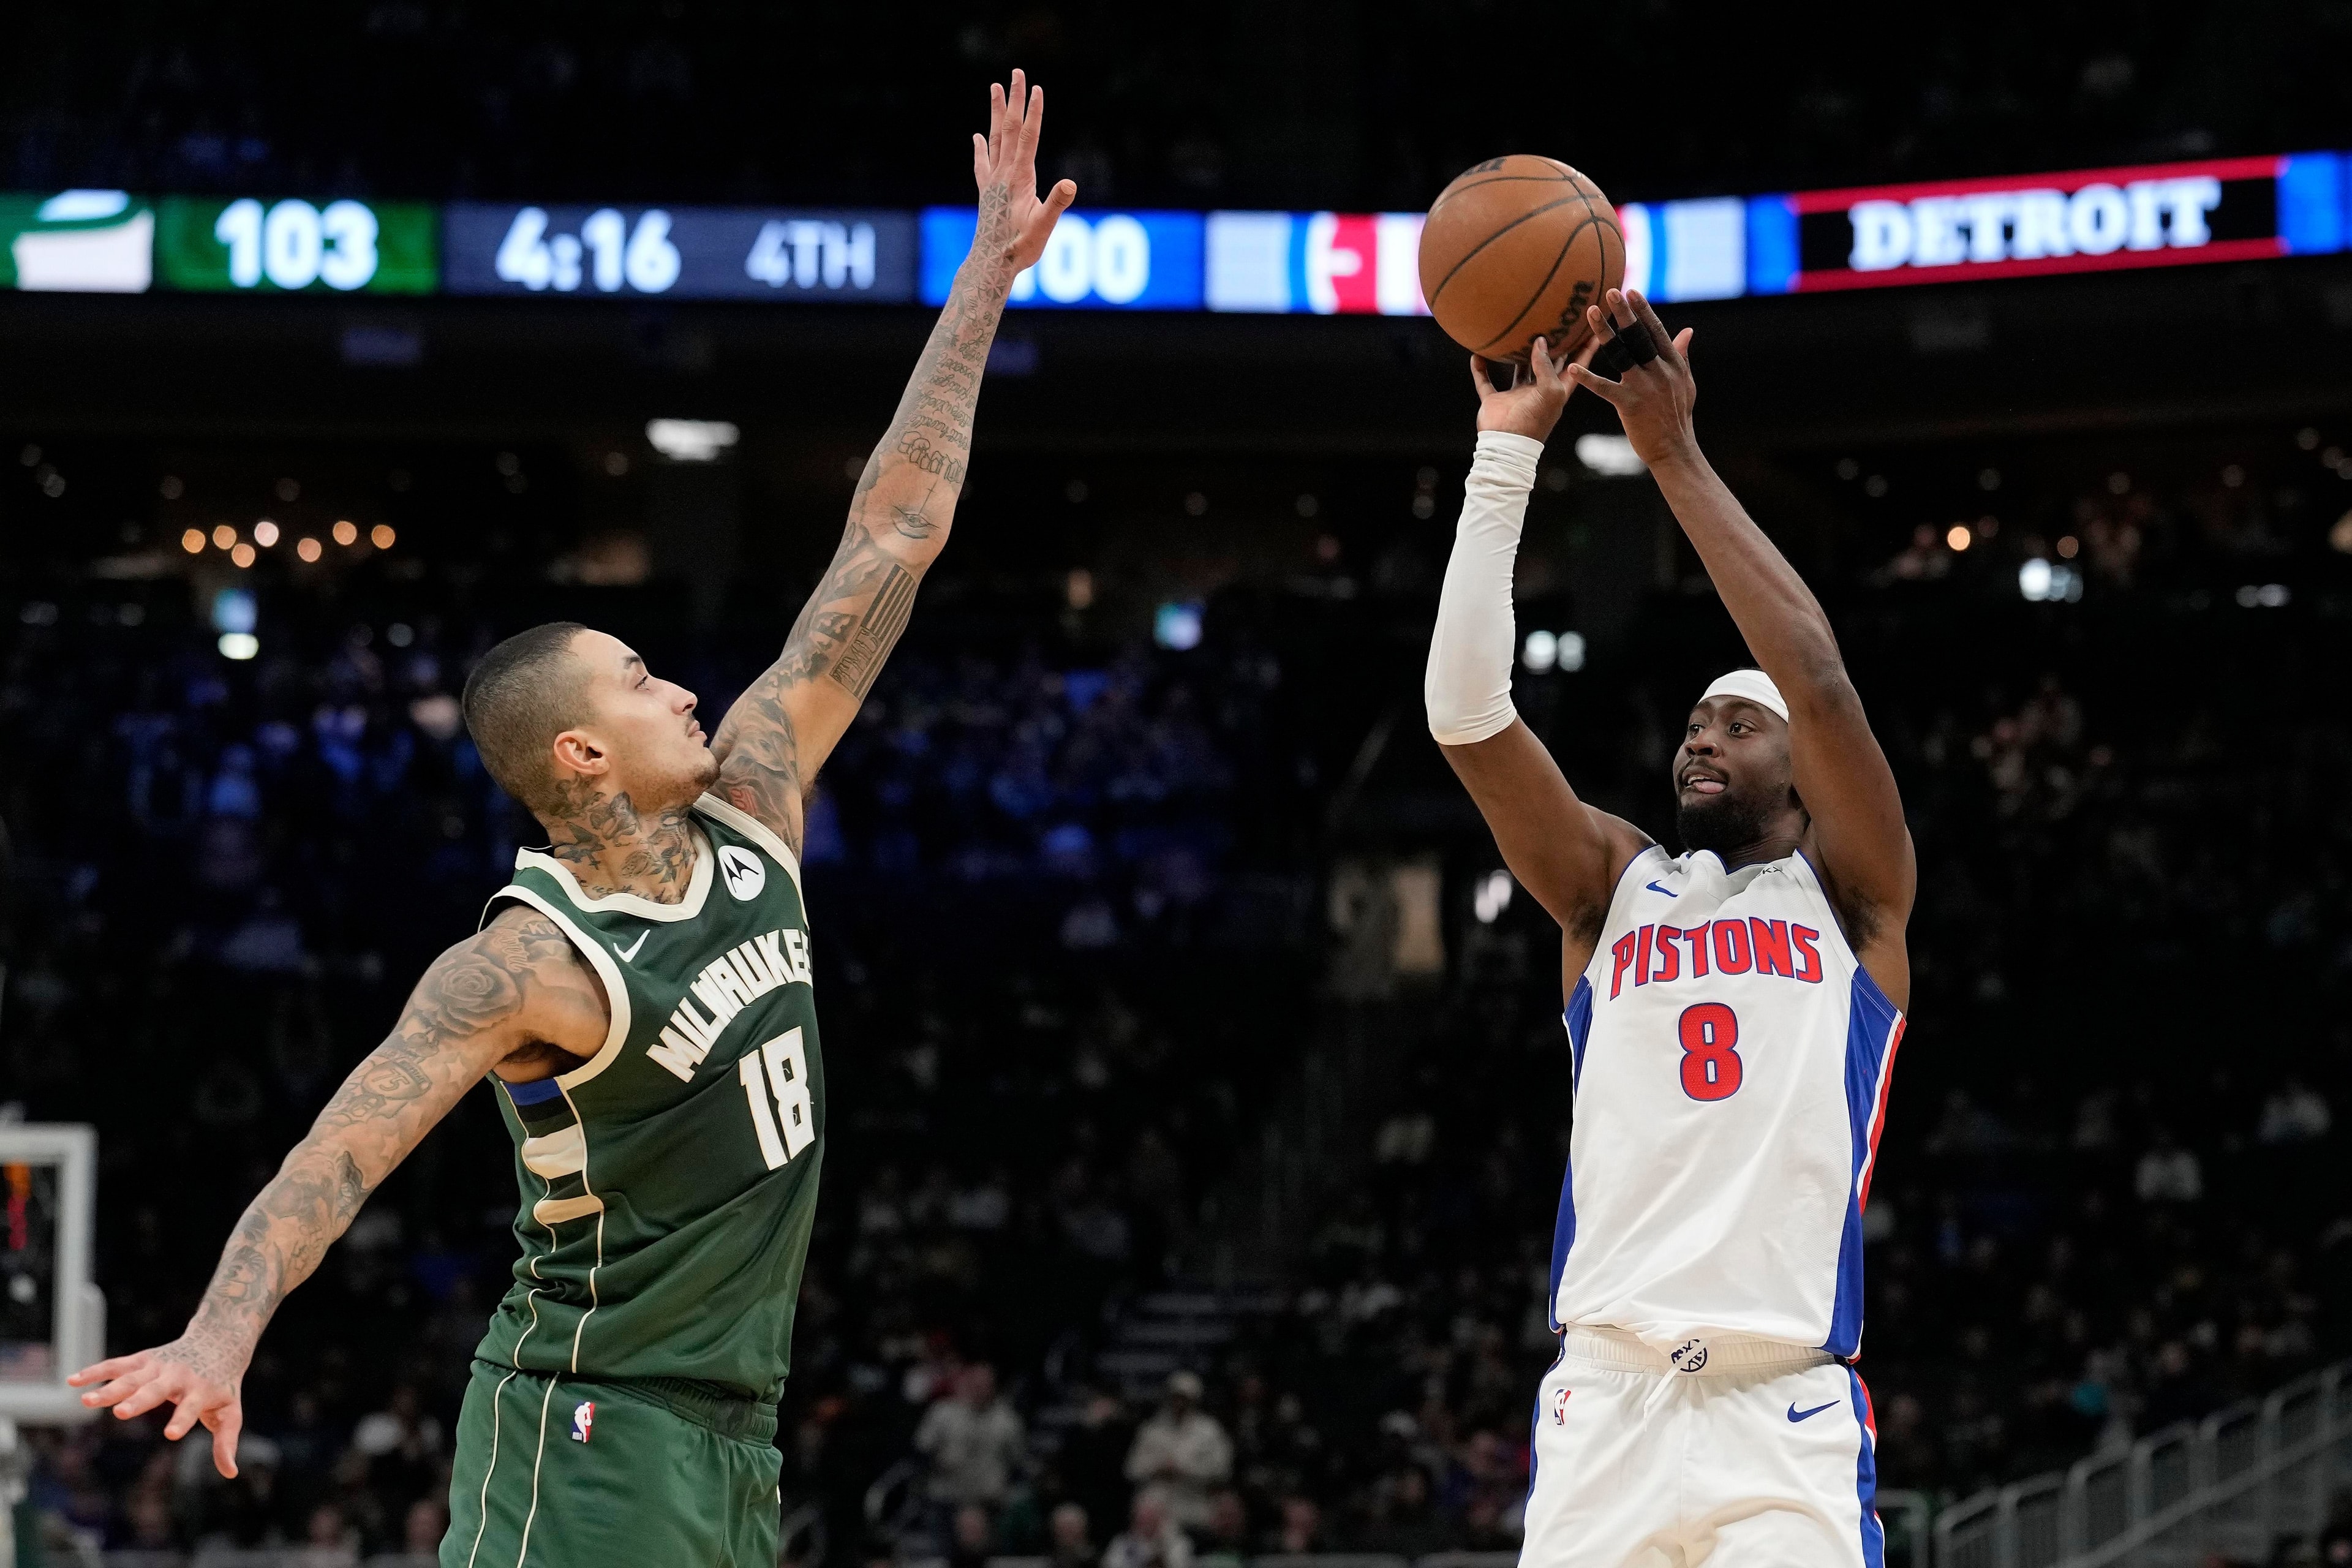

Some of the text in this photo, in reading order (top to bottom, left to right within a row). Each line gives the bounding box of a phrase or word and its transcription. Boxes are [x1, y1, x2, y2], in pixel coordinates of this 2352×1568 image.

[215, 198, 379, 290] 103
[496, 206, 680, 293] 4:16
[746, 219, 876, 289] 4TH
[1011, 214, 1149, 304] 00
[1849, 175, 2221, 271] DETROIT
[1610, 916, 1823, 1001] PISTONS
[646, 929, 813, 1083] MILWAUKEE
[1678, 1002, 1743, 1101] 8
[739, 1026, 815, 1170] 18
